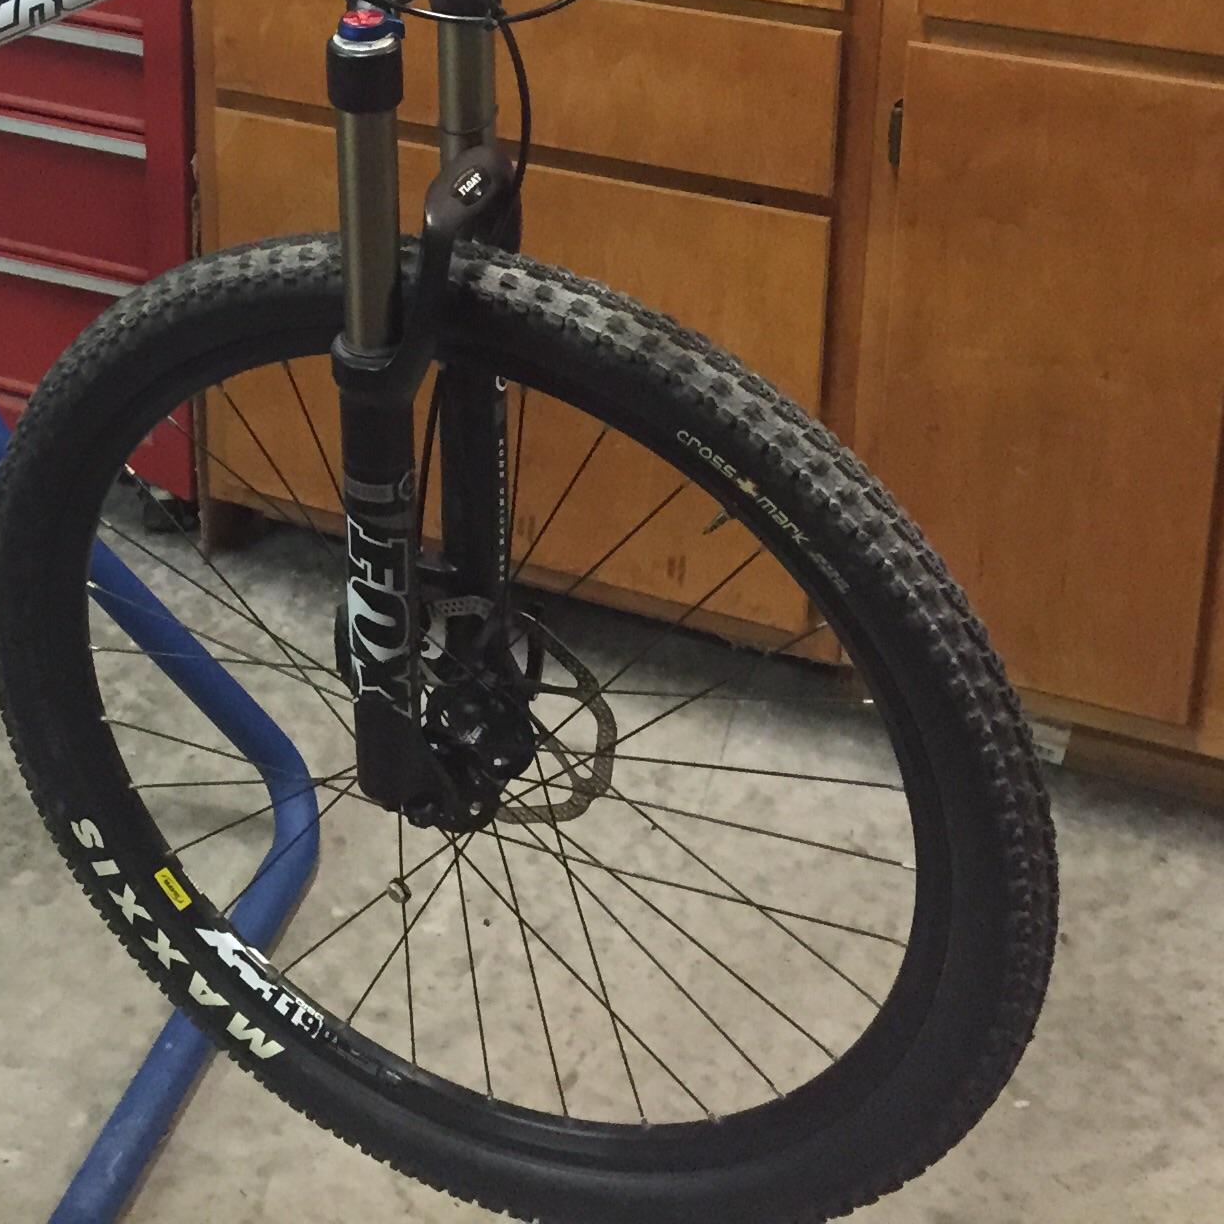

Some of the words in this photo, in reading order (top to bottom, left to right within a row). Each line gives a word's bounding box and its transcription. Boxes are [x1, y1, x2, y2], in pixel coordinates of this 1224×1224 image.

[458, 172, 482, 196] FLOAT
[347, 513, 413, 719] FOX
[70, 818, 286, 1060] MAXXIS
